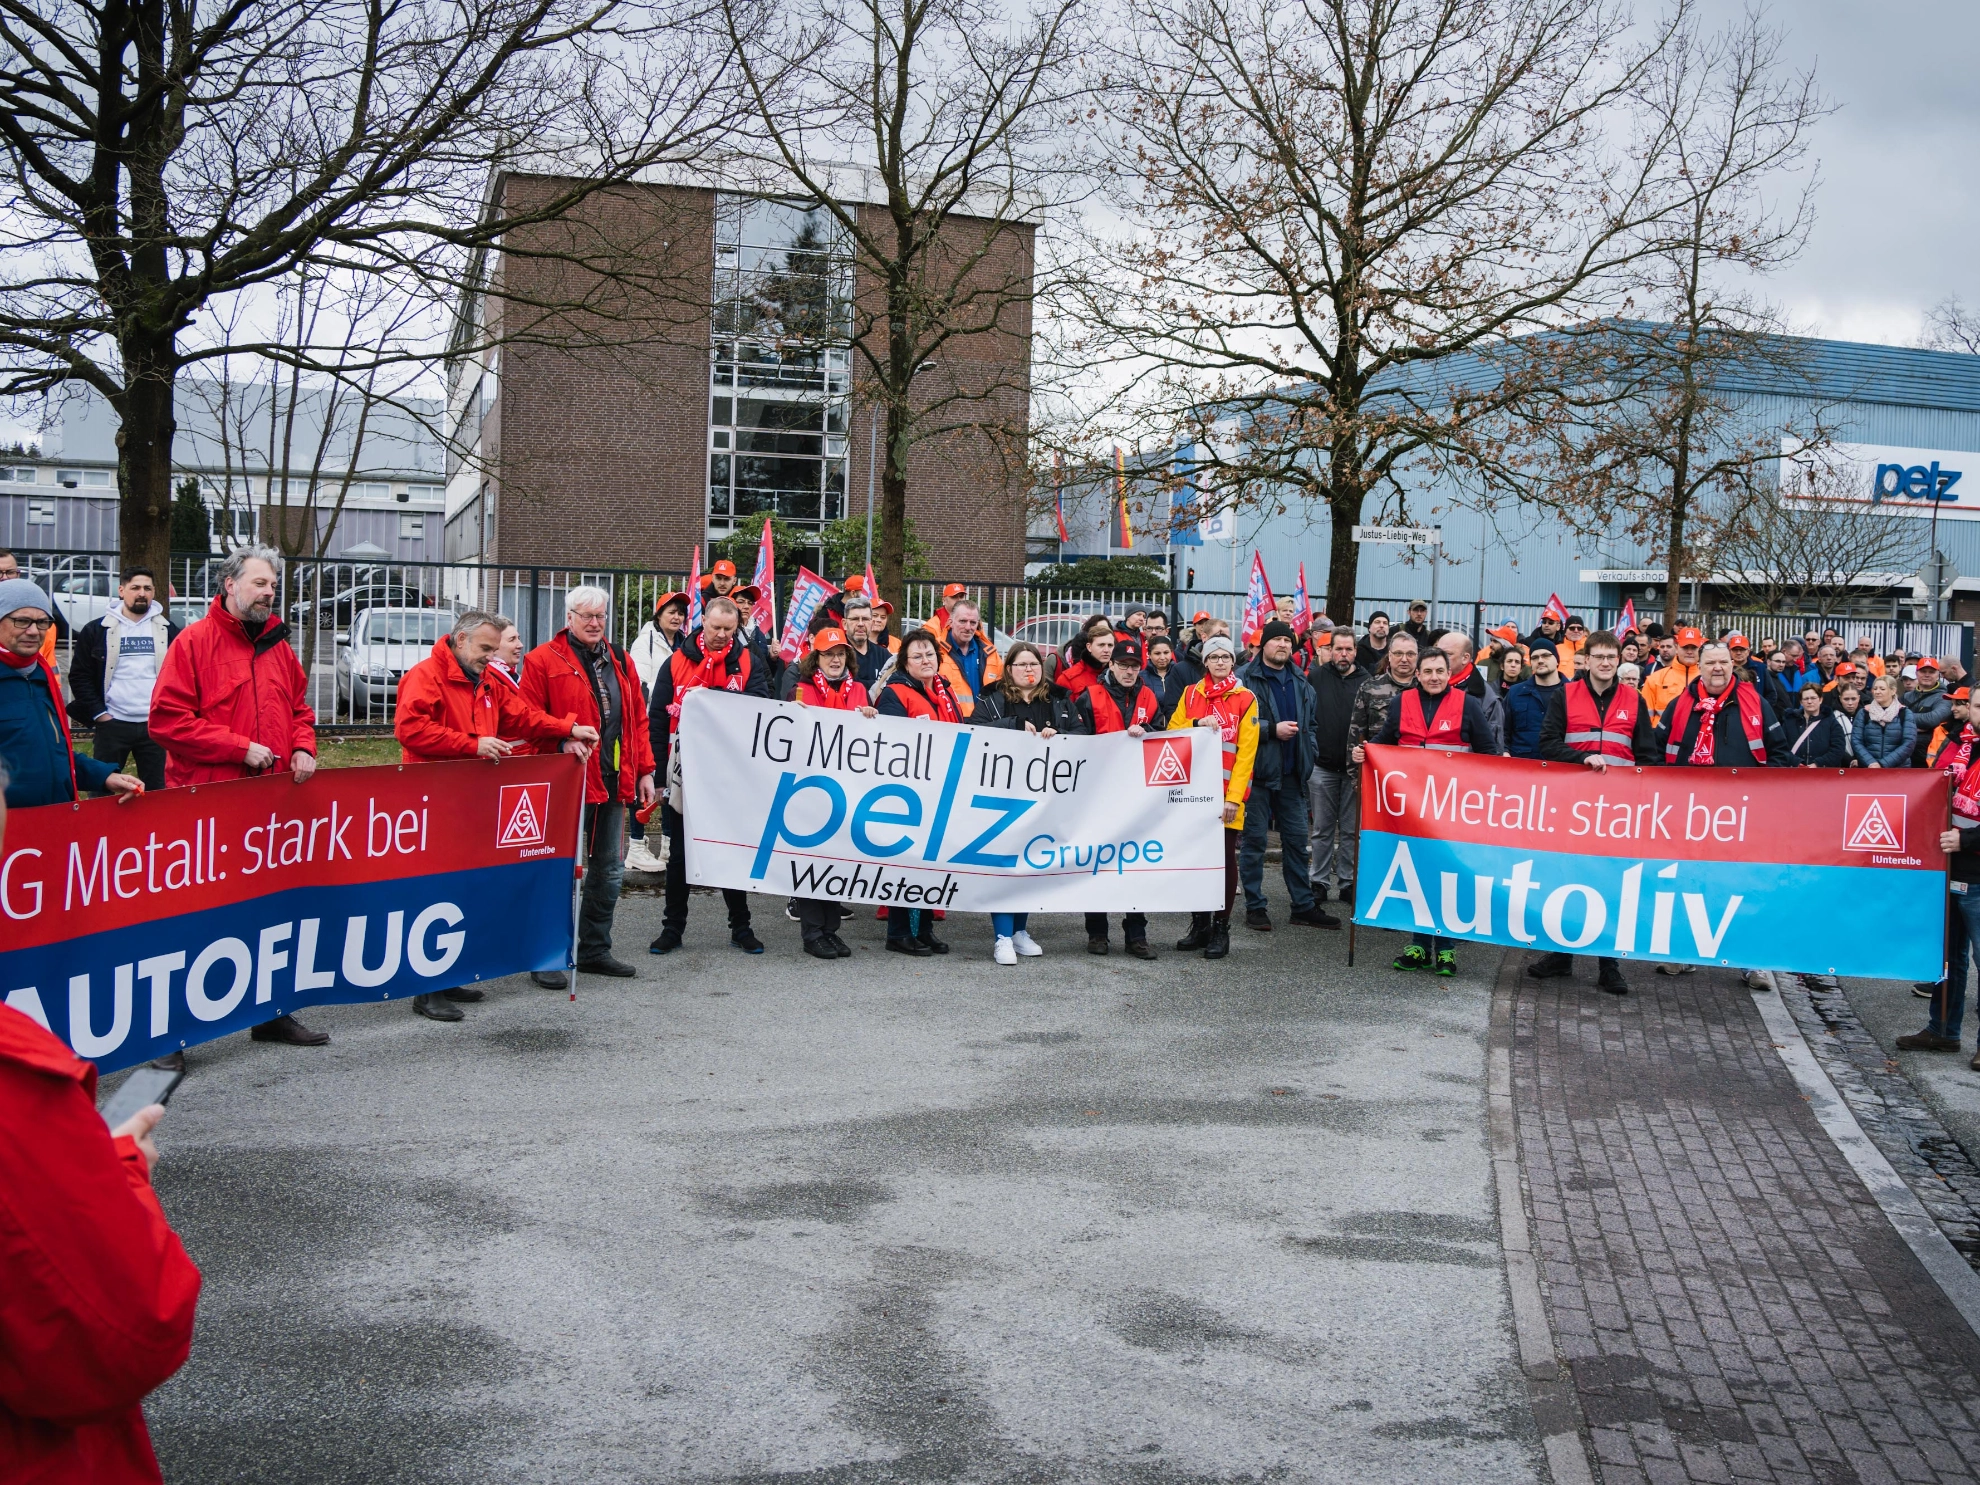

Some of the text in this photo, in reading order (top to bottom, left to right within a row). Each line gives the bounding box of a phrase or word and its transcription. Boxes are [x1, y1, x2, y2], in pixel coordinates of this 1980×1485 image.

[1873, 461, 1963, 507] pelz
[1359, 529, 1426, 543] Justus-Liebig-Weg
[1597, 571, 1665, 581] Verkaufs-shop
[752, 712, 1086, 793] IG Metall in der
[749, 732, 1037, 879] pelz
[1023, 834, 1163, 875] Gruppe
[1374, 769, 1749, 842] IG Metall: stark bei
[0, 795, 428, 920] G Metall: stark bei
[790, 860, 959, 909] Wahlstedt
[1366, 841, 1744, 959] Autoliv
